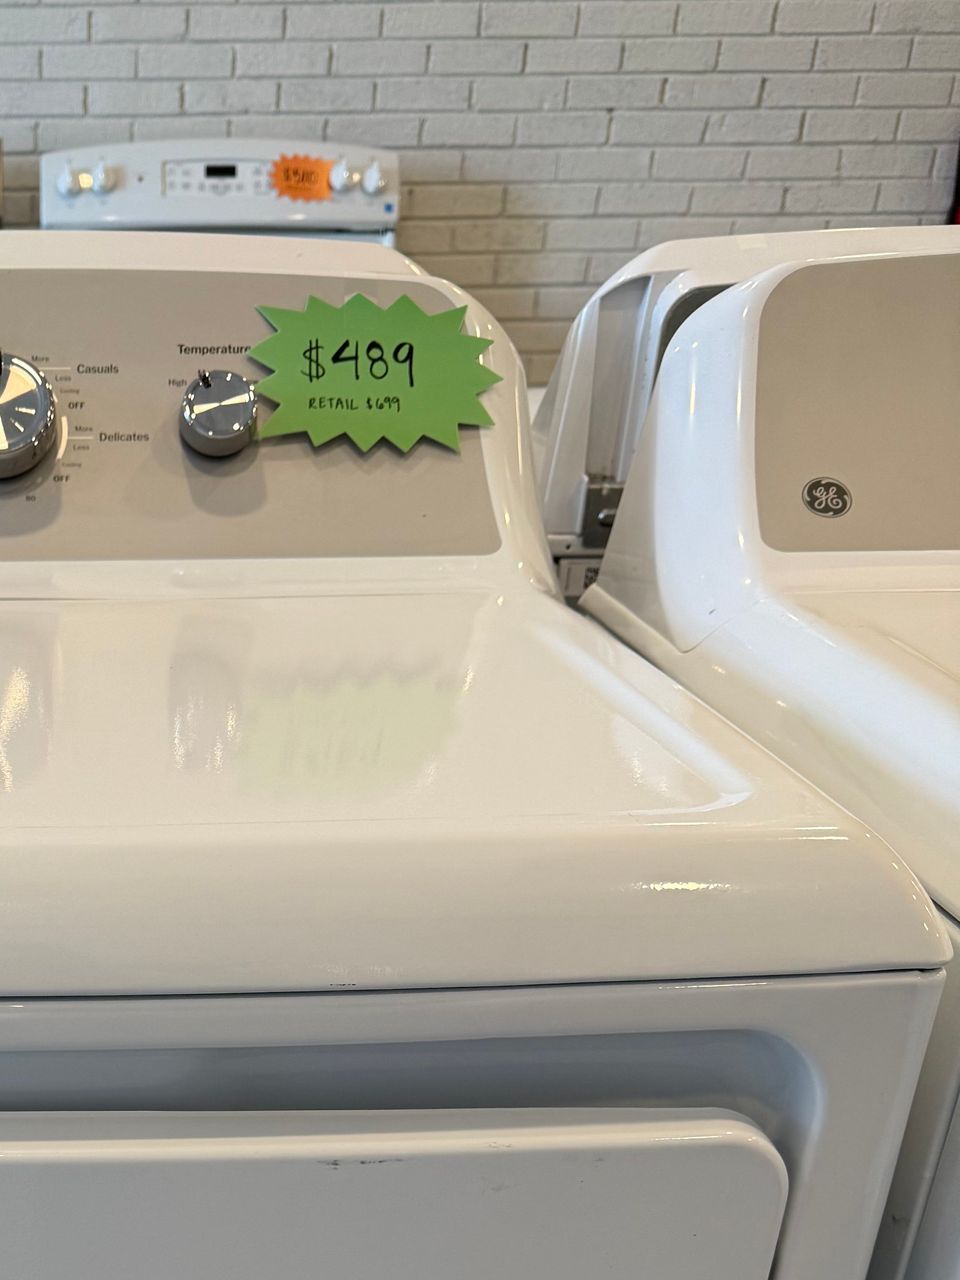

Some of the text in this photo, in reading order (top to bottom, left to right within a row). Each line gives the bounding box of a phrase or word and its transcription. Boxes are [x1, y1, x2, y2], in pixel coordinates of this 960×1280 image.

[300, 338, 415, 388] $489
[76, 363, 119, 375] Casuals
[168, 378, 187, 388] High
[68, 401, 85, 410] OFF
[308, 396, 401, 412] RETAIL $699
[99, 432, 150, 442] Delicates
[53, 474, 70, 483] OFF
